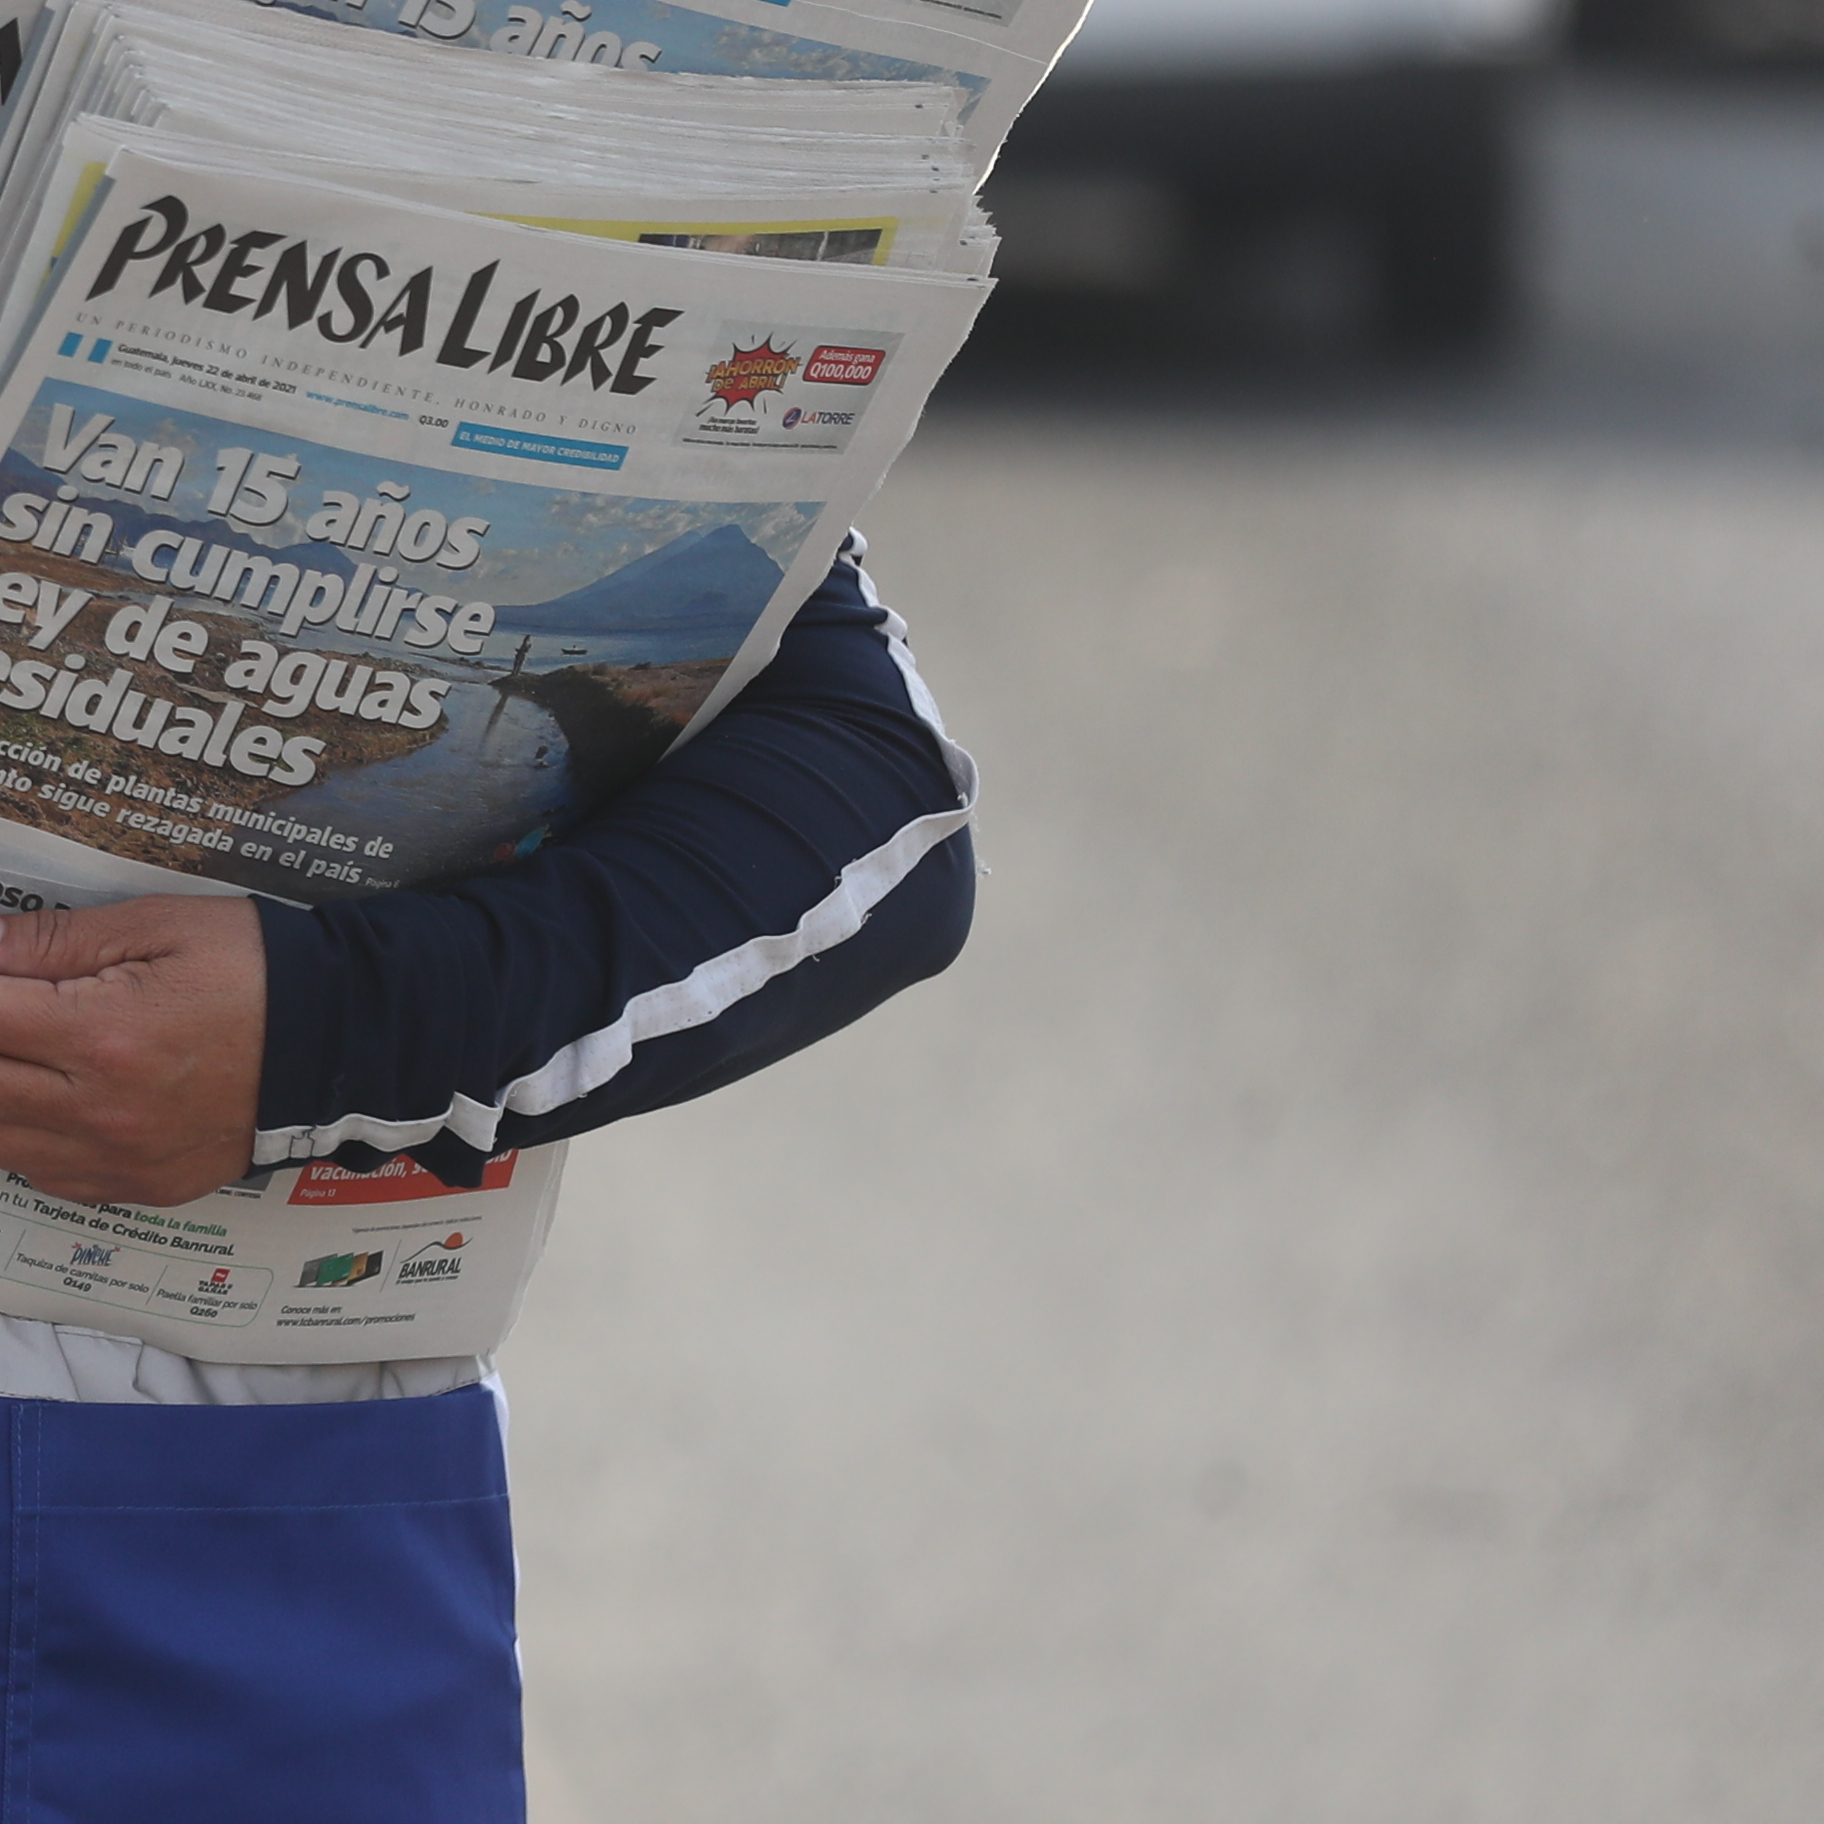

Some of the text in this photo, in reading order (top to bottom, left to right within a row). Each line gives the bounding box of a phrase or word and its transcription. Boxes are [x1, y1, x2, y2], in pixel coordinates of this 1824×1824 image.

[88, 194, 685, 396] PRENSA LIBRE
[809, 360, 872, 386] Q100,000
[43, 409, 488, 573] Van 15 años
[133, 527, 498, 662] cumplirse
[107, 594, 210, 673] de
[221, 641, 450, 736] aguas
[40, 781, 108, 818] sigue
[117, 808, 233, 855] rezagada
[239, 835, 273, 863] en
[276, 845, 305, 870] el
[306, 853, 362, 889] país
[66, 755, 105, 786] de
[109, 772, 204, 815] plantas
[209, 803, 358, 853] municipales
[362, 833, 394, 861] de
[11, 1192, 30, 1208] tu
[30, 1197, 80, 1225] Tarjeta
[82, 1214, 108, 1232] de
[111, 1220, 169, 1247] Crédito
[133, 1207, 166, 1227] toda
[167, 1214, 182, 1230] la
[183, 1217, 227, 1240] familia
[400, 1256, 461, 1279] BANRURAL
